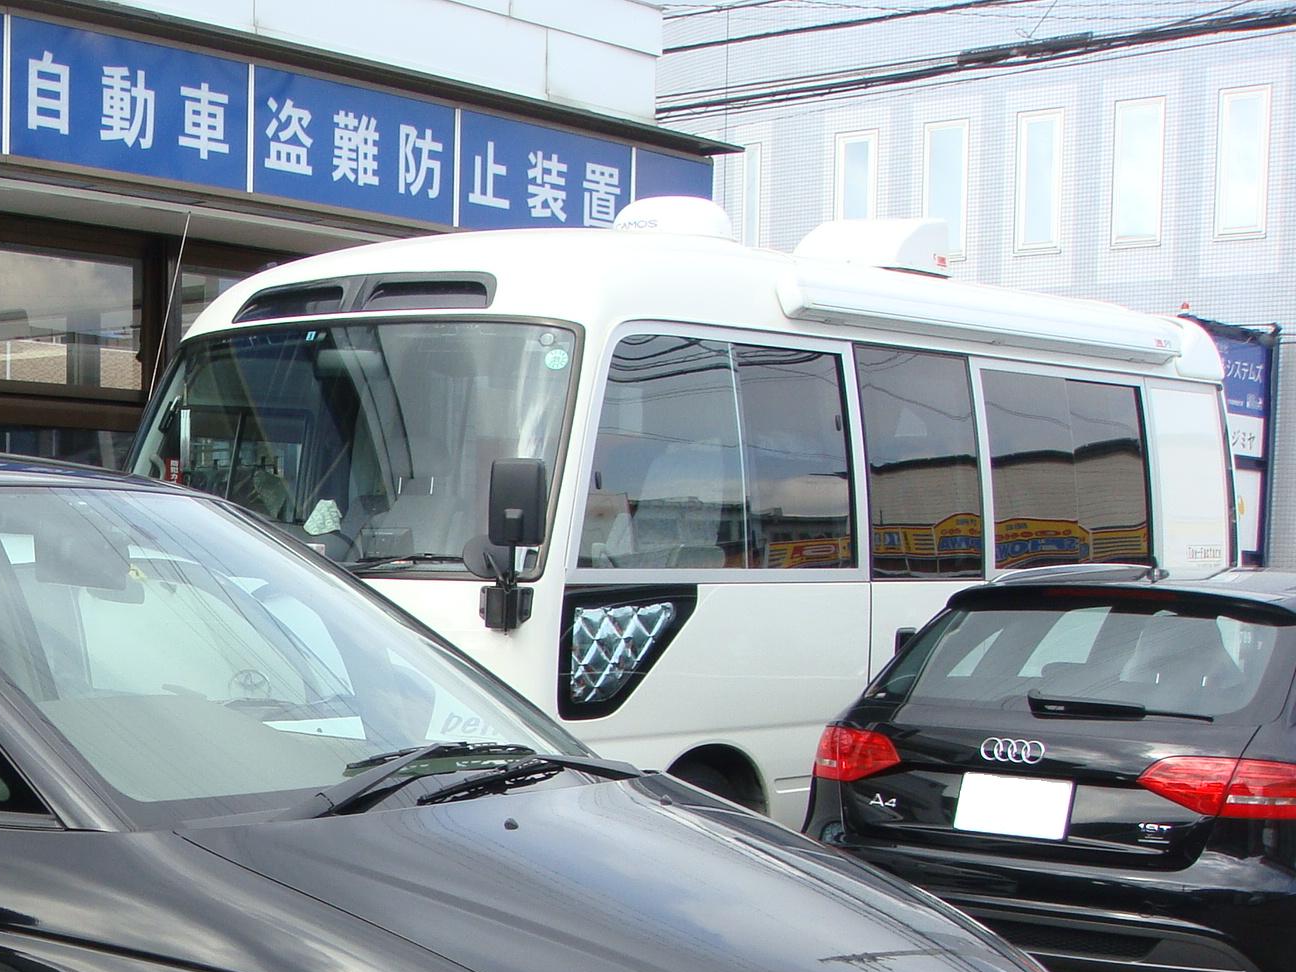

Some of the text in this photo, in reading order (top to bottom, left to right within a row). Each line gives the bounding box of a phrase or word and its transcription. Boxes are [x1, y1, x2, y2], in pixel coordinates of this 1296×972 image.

[28, 50, 621, 229] 自動車盗難防止装置
[1220, 357, 1264, 383] システムズ
[869, 793, 897, 807] A4
